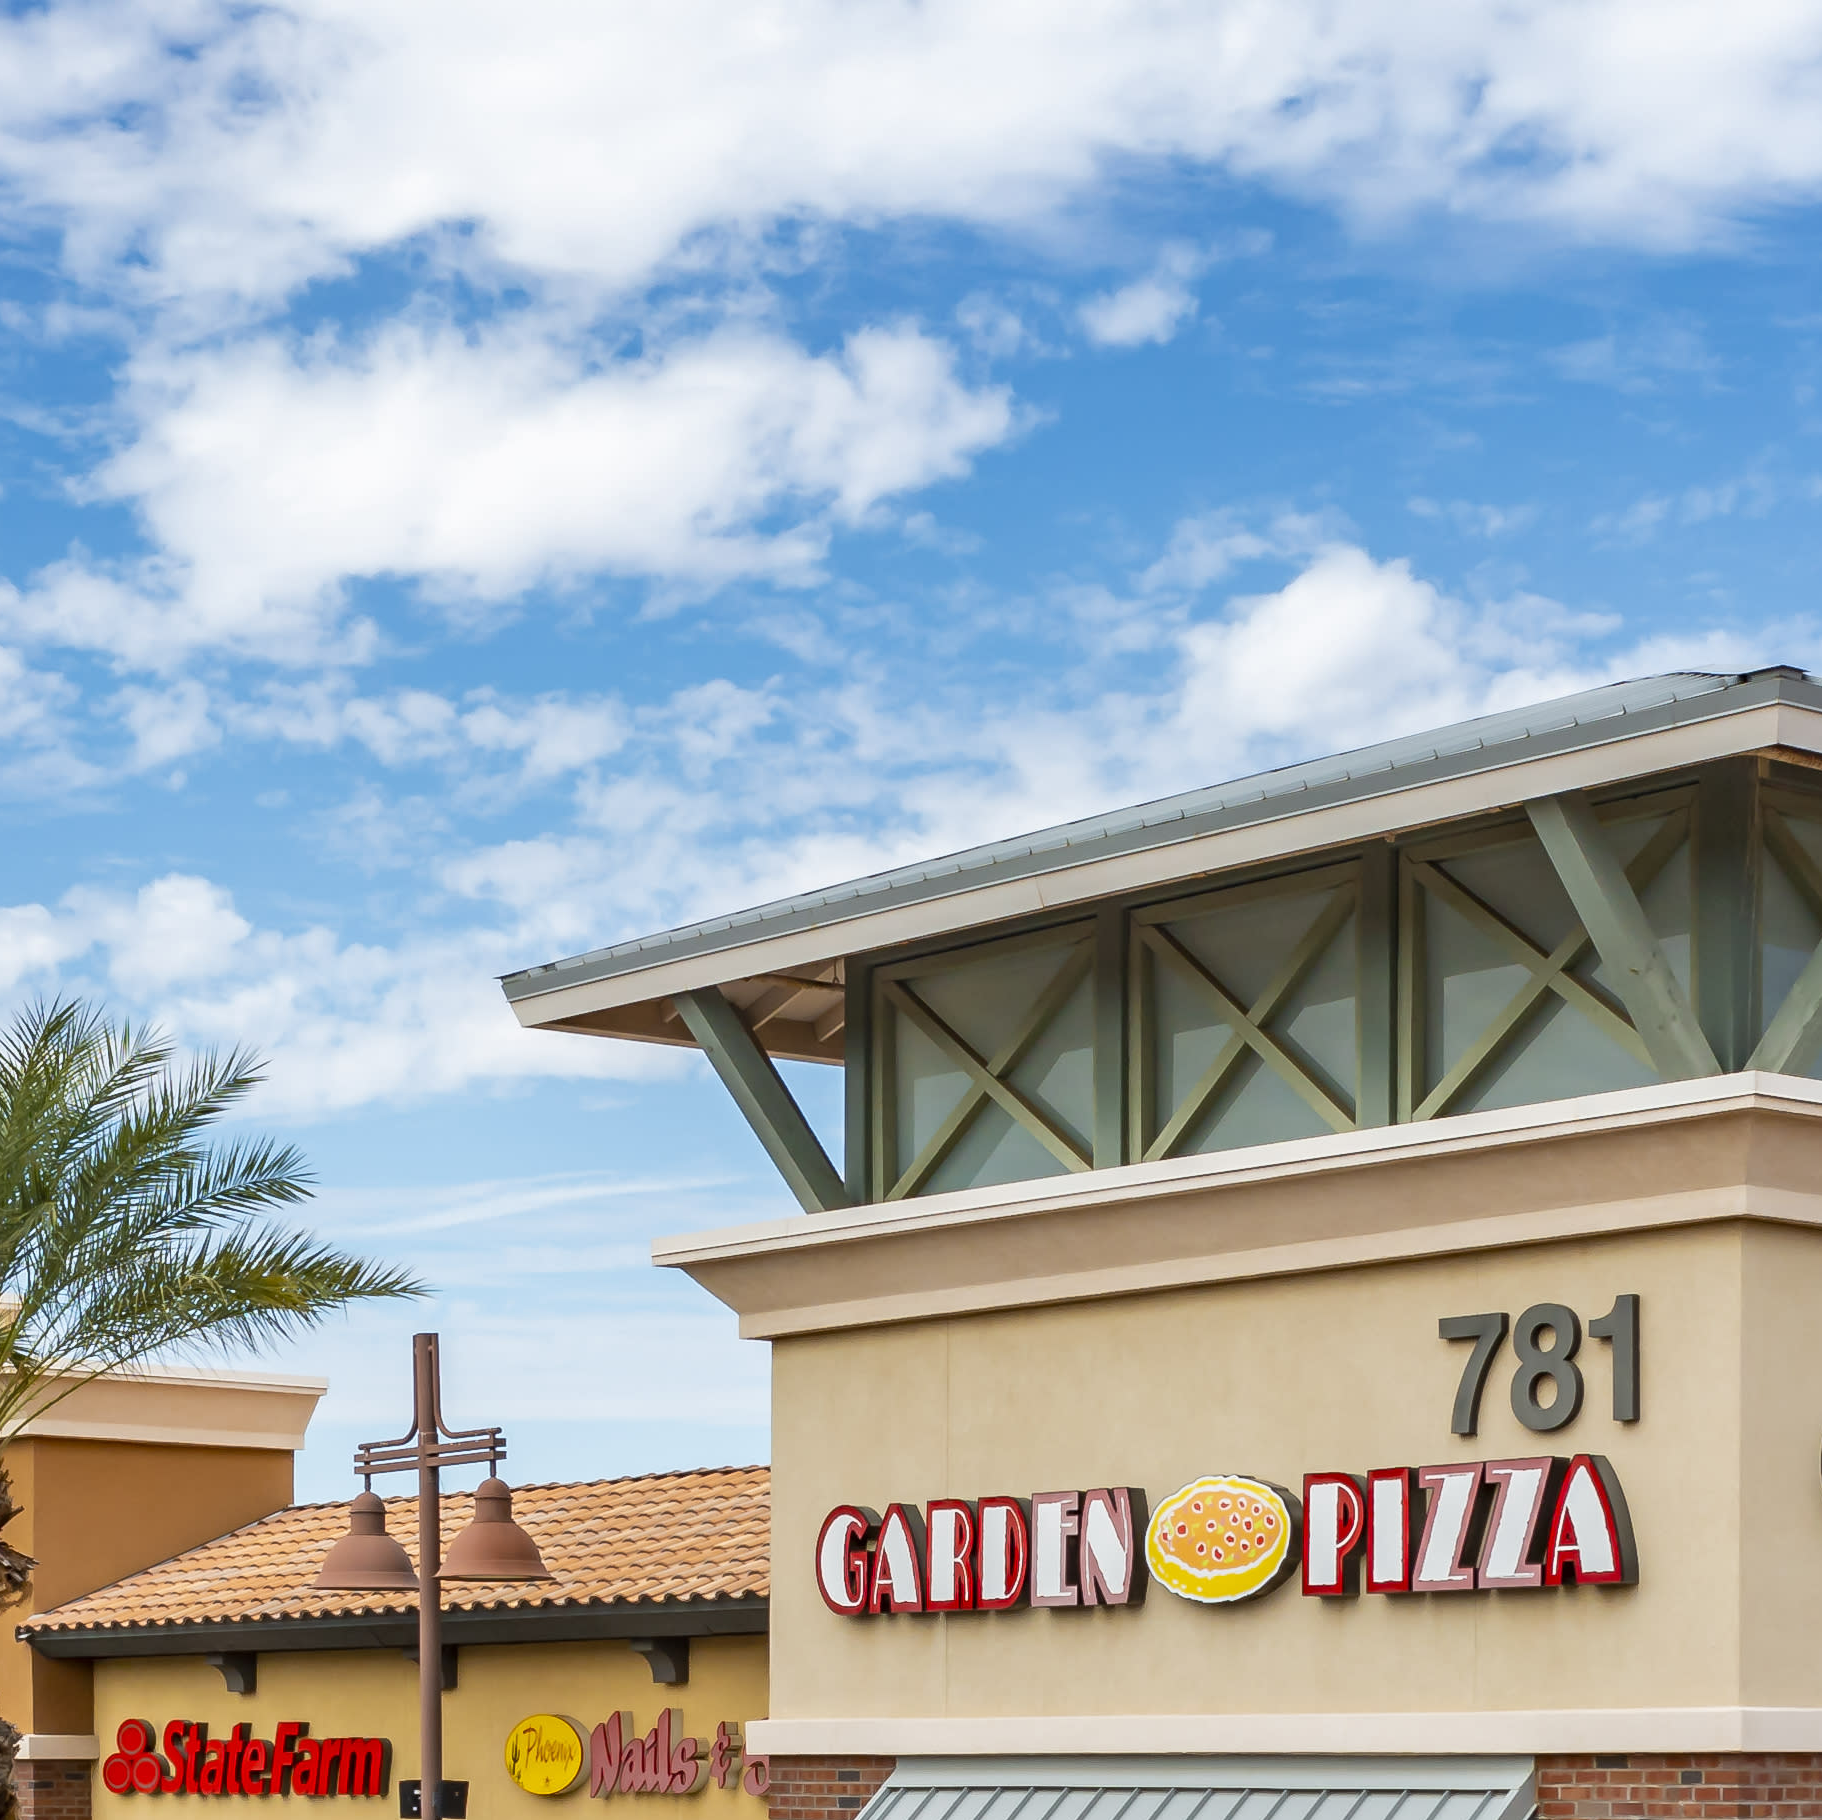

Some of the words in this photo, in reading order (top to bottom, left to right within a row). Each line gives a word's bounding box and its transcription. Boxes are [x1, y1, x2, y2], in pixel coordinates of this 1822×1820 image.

[1437, 1293, 1641, 1437] 781
[815, 1486, 1144, 1616] GARDEN
[1302, 1453, 1639, 1597] PIZZA
[522, 1724, 576, 1771] Phoenix
[589, 1707, 700, 1799] Nails
